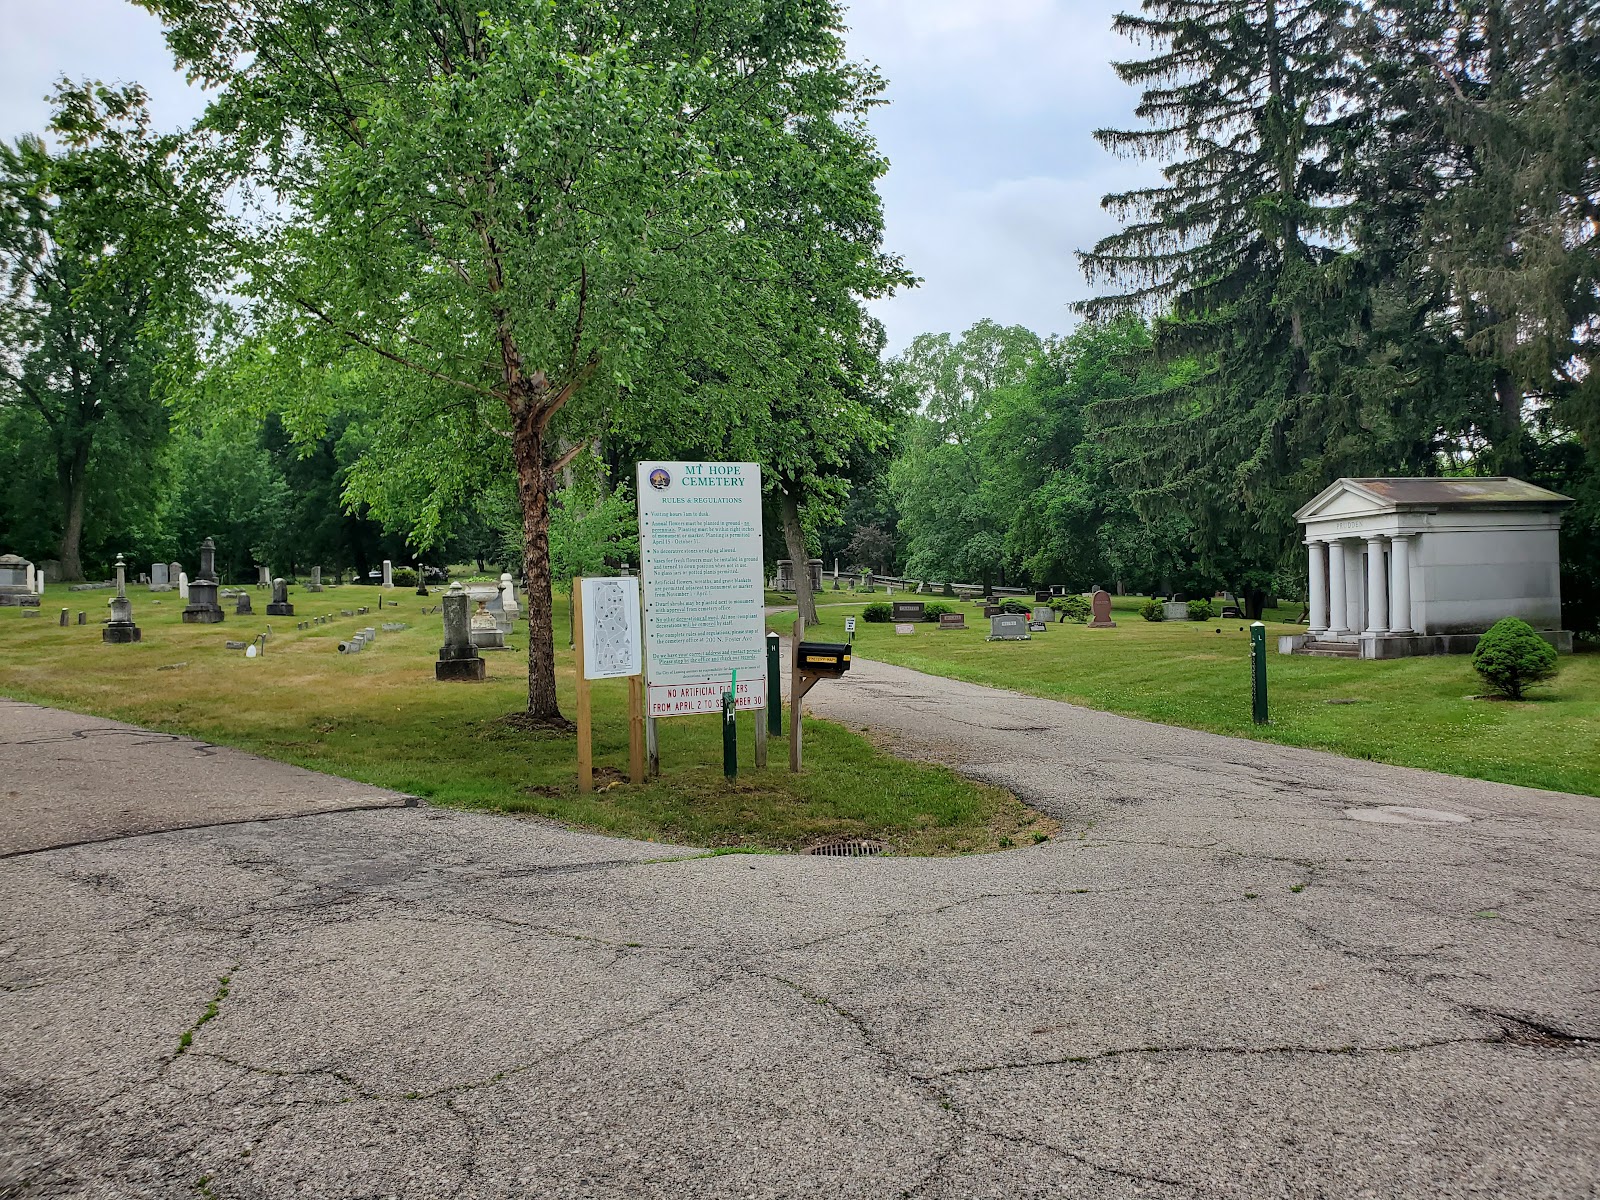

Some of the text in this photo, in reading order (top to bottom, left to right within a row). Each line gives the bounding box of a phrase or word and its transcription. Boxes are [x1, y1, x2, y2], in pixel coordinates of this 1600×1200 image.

[686, 466, 740, 474] MT HOPE
[682, 477, 745, 486] CEMETERY
[1336, 521, 1363, 529] PRUDDEN
[668, 684, 748, 698] NO ARTIFICIAL FLOERS
[654, 696, 762, 712] FROM APRIL 2 TO SEMBER 30
[727, 708, 735, 724] H
